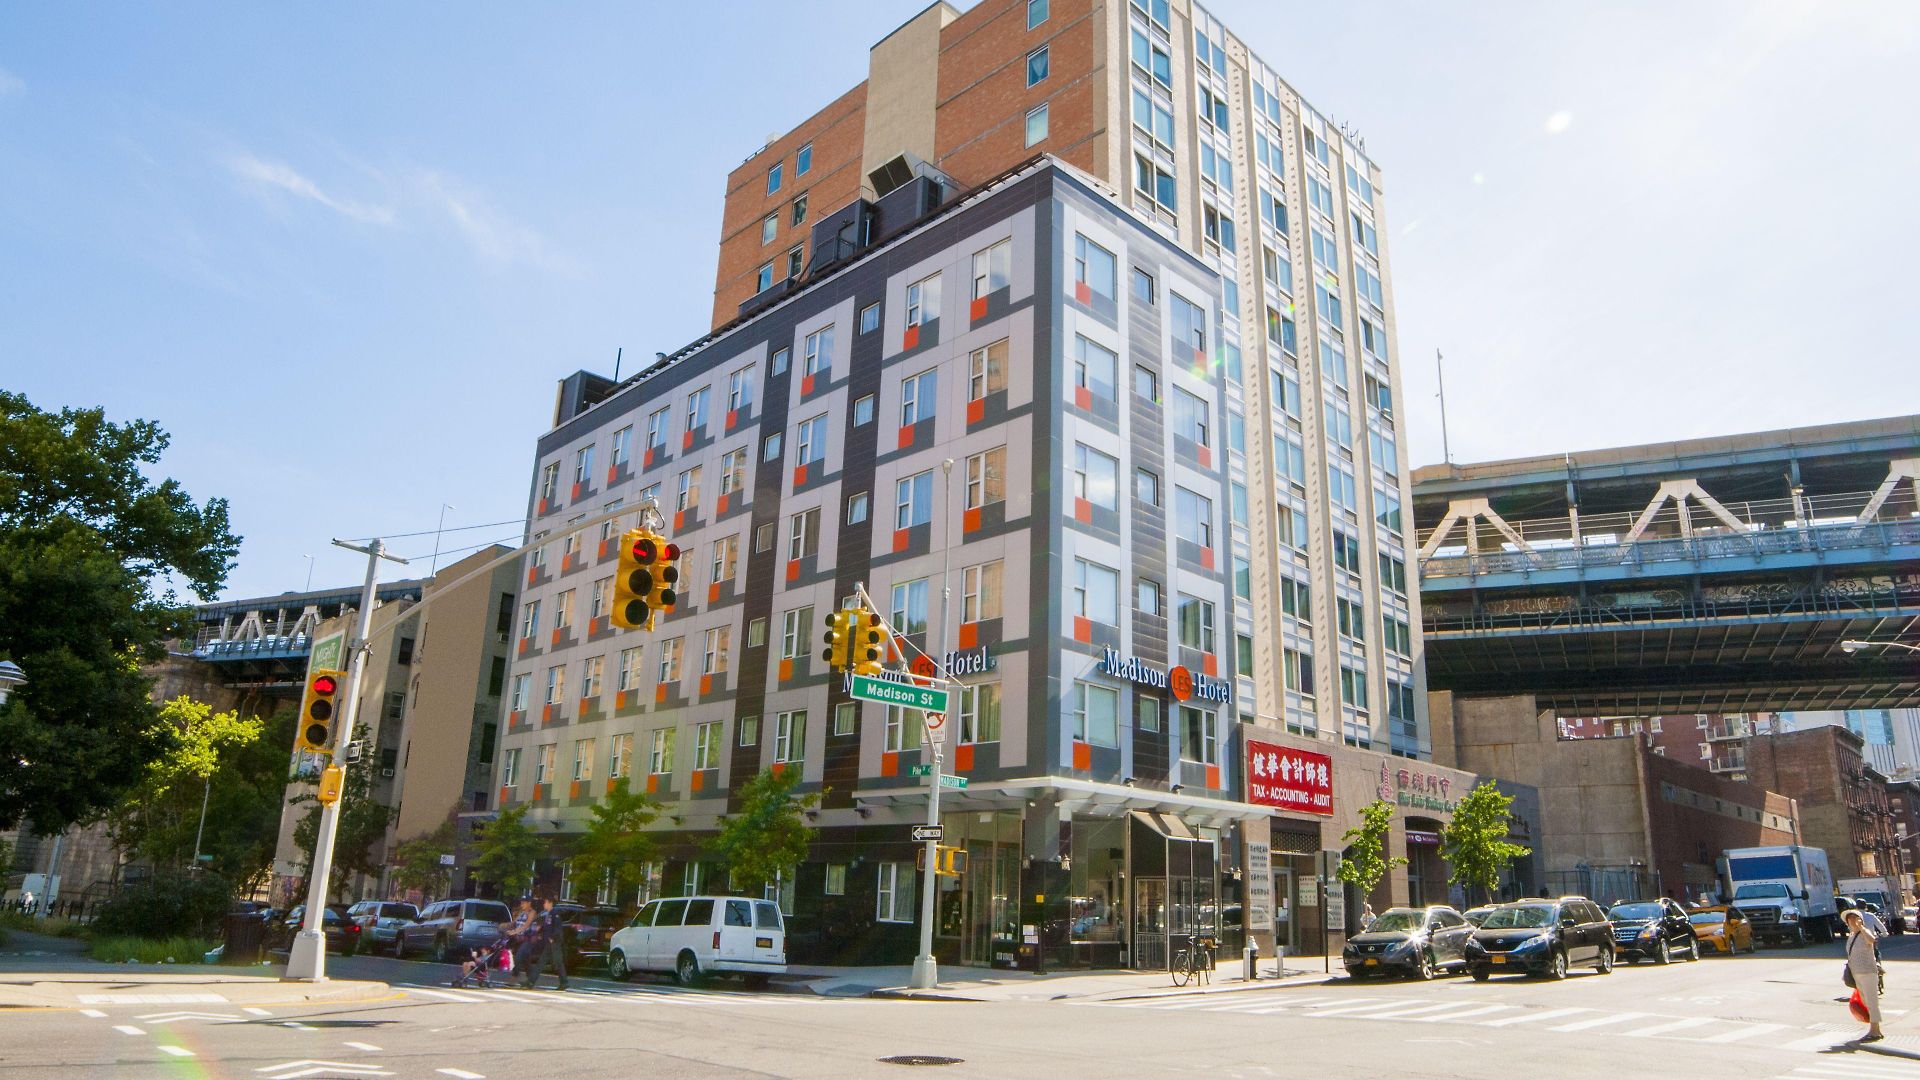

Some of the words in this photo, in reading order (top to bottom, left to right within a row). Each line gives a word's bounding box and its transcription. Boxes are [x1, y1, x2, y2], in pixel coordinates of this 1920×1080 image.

[945, 645, 987, 677] Hotel
[1106, 647, 1166, 688] Madison
[1173, 674, 1191, 693] LES
[1197, 674, 1232, 704] Hotel
[867, 682, 915, 703] Madison
[920, 693, 933, 706] St
[940, 775, 960, 788] MADISON
[1252, 783, 1266, 798] TAX
[1270, 786, 1309, 804] ACCOUNTING
[1313, 793, 1331, 807] AUDIT
